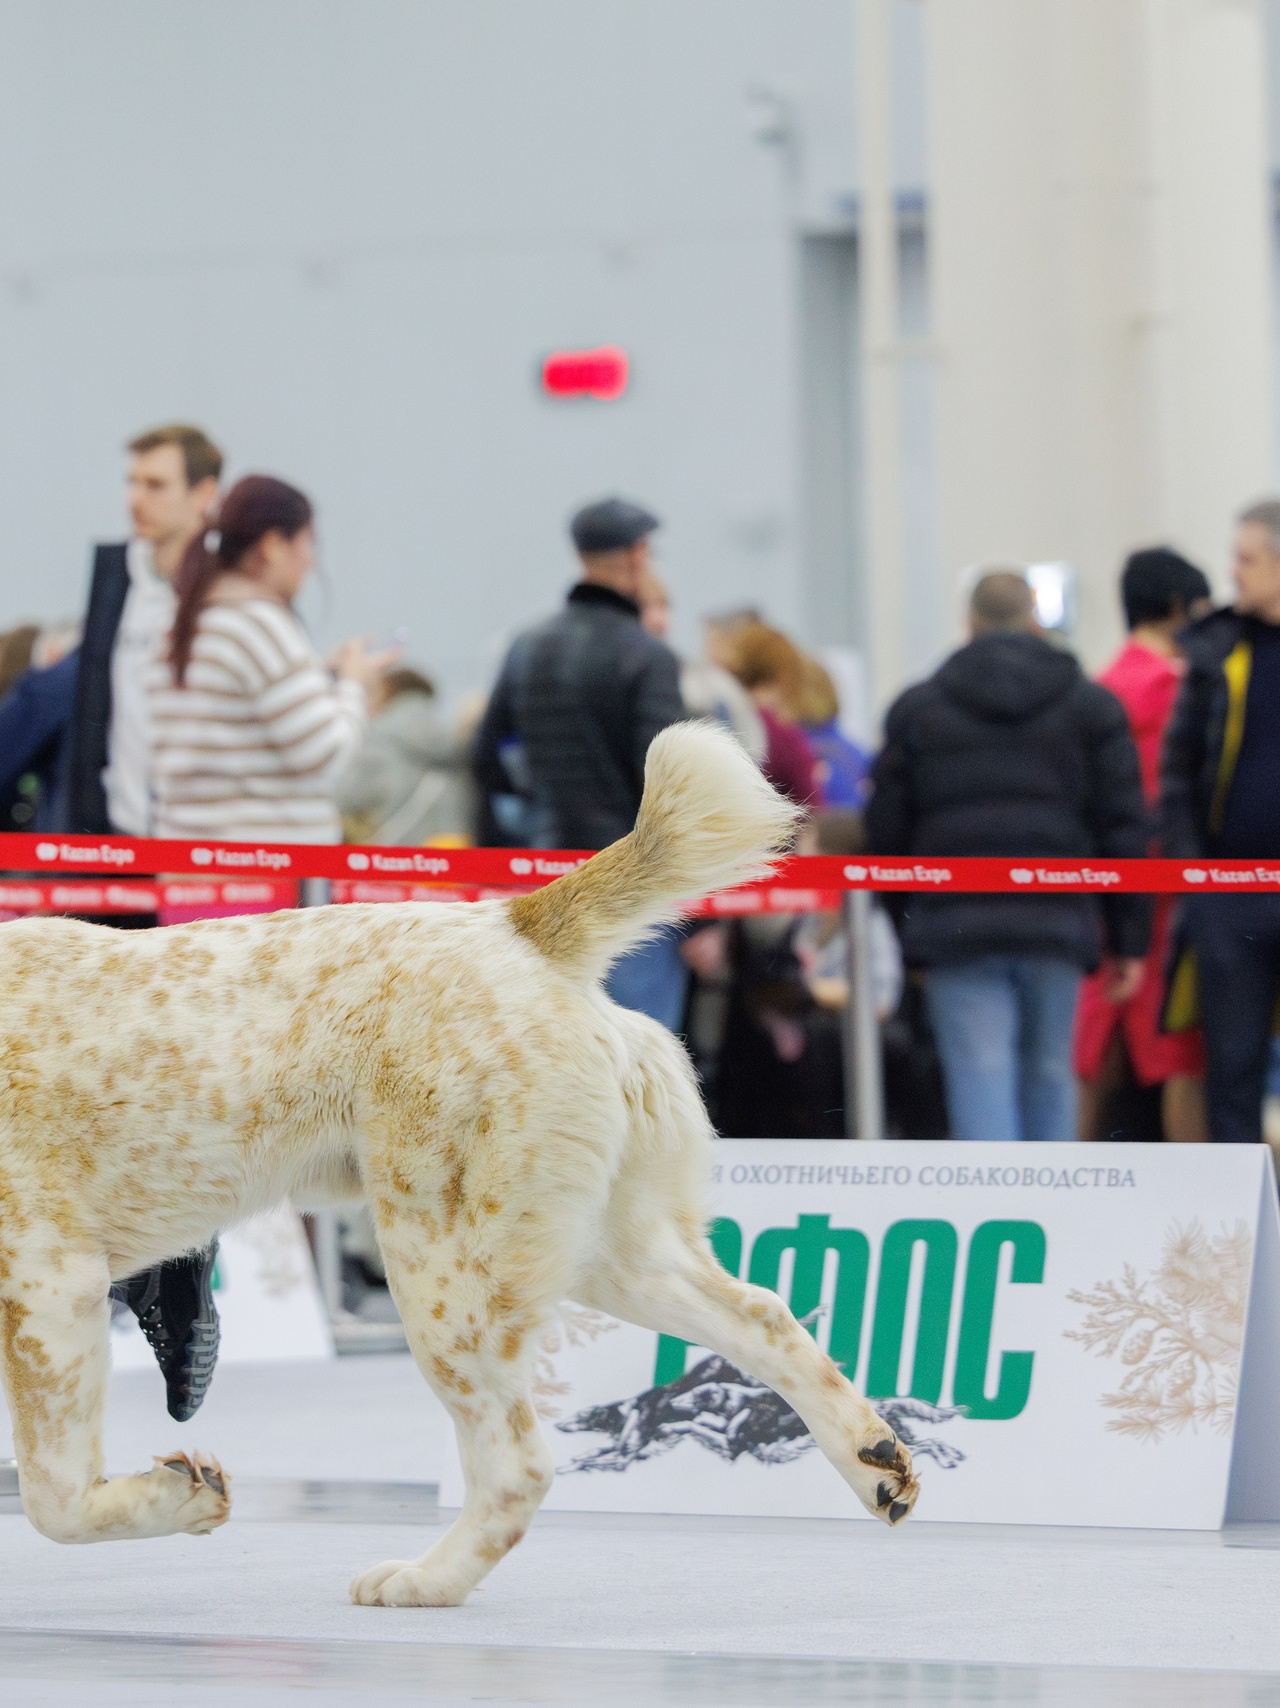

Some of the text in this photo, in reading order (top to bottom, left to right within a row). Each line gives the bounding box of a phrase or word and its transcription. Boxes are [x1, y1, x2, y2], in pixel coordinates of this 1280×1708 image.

[60, 843, 135, 867] Kazan Expo
[215, 849, 291, 870] Kazan Expo
[371, 854, 449, 875] Kazan Expo
[869, 865, 952, 884] Kazan Expo
[1036, 867, 1120, 886] Kazan Expo
[1209, 868, 1257, 883] Kazan
[730, 1164, 911, 1186] ОХОТНИЧЬЕГО
[919, 1165, 1136, 1189] СОБАКОВОДСТВА
